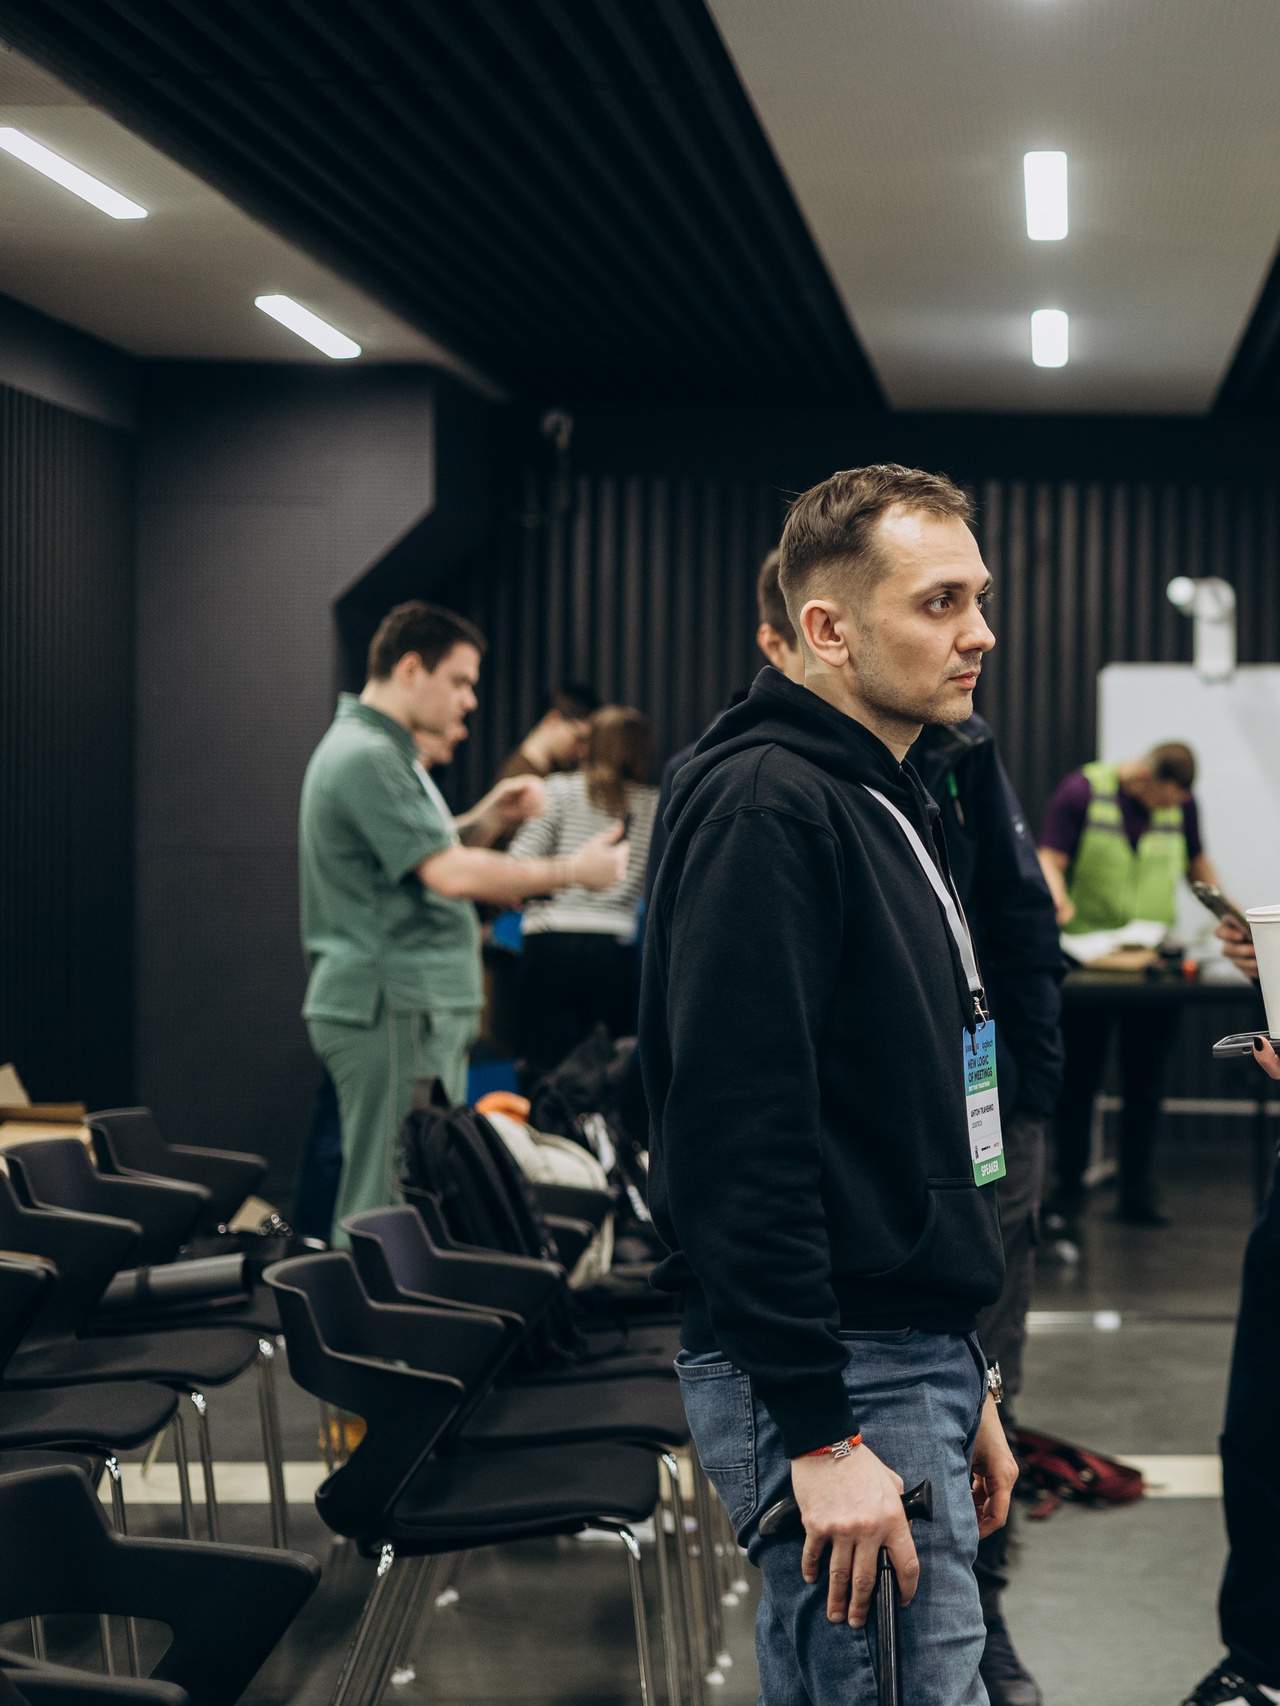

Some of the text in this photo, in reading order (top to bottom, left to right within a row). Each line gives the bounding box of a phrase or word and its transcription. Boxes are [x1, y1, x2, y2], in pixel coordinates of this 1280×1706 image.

[968, 1055, 989, 1070] NEW LOGIC
[968, 1067, 993, 1083] OF MEETINGS
[980, 1160, 999, 1177] SPEAKER
